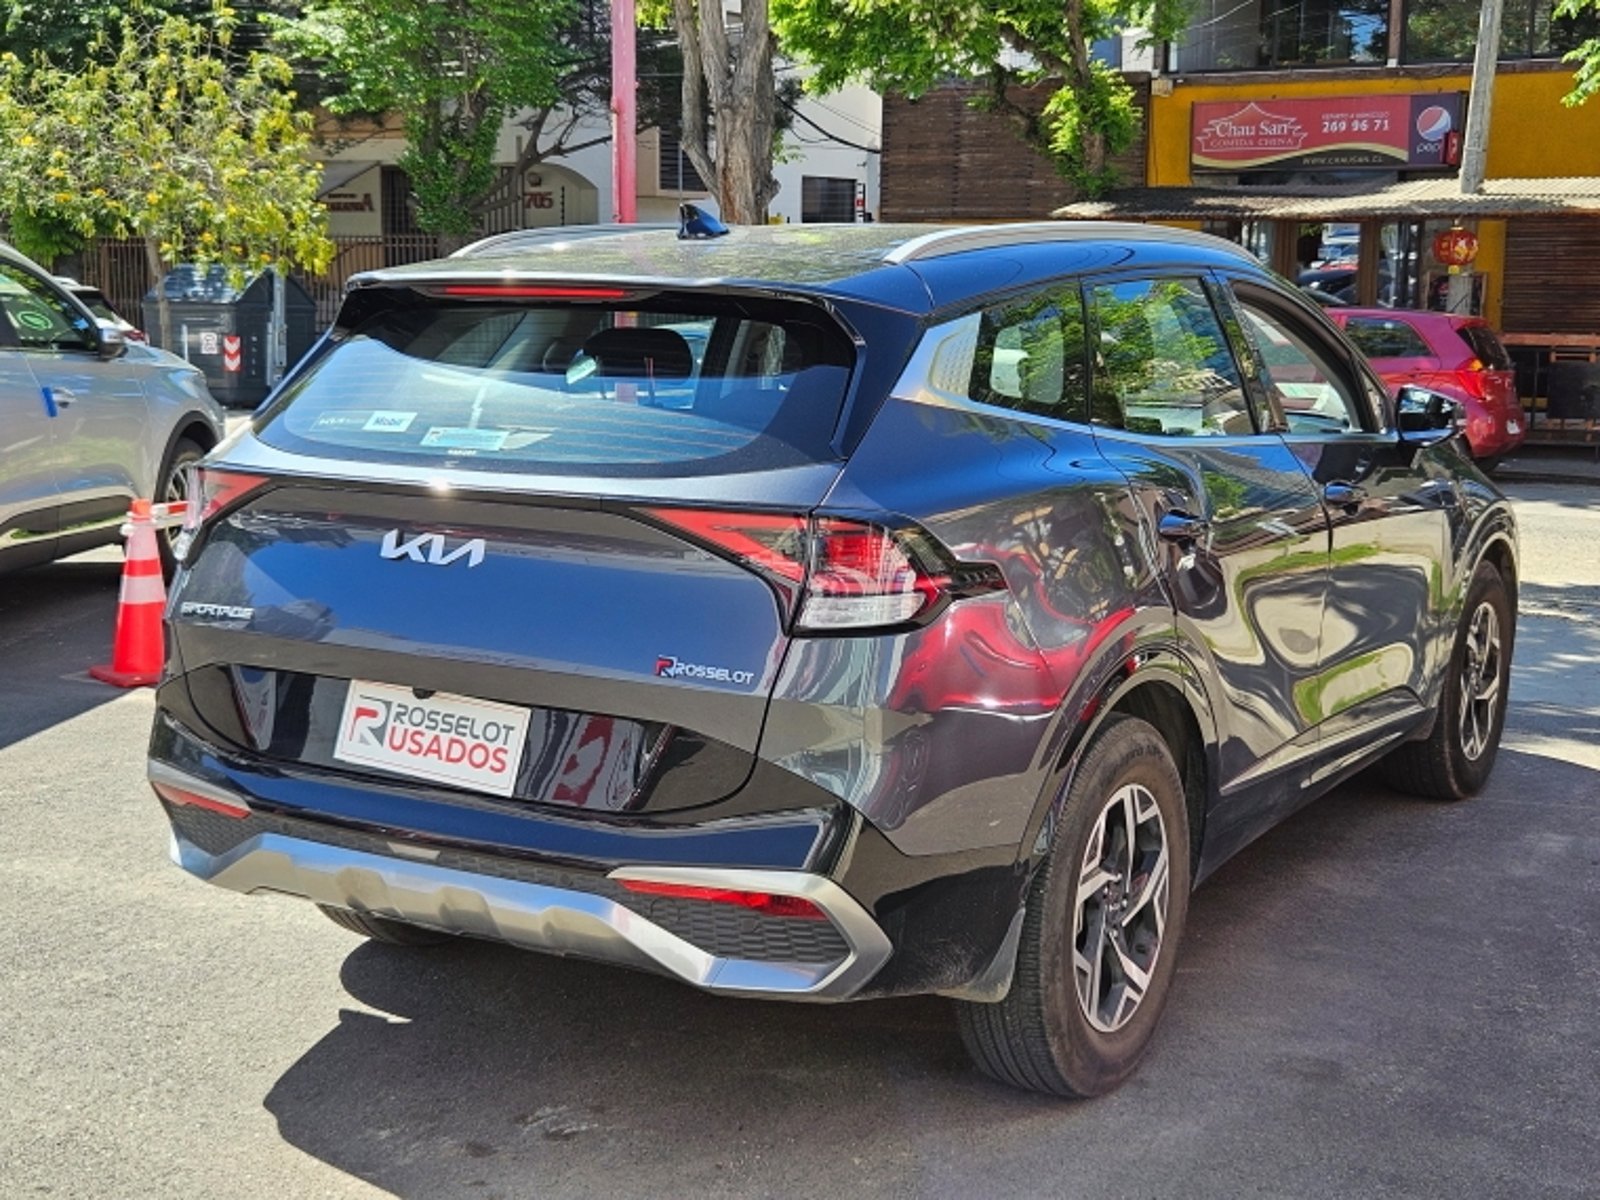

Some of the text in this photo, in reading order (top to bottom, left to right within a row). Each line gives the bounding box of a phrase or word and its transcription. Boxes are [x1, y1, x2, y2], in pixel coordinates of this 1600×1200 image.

[1215, 120, 1287, 137] Chau San
[1321, 119, 1390, 133] 269 96 71
[380, 528, 486, 568] KIA
[393, 703, 515, 746] ROSSELOT
[388, 726, 509, 773] USADOS
